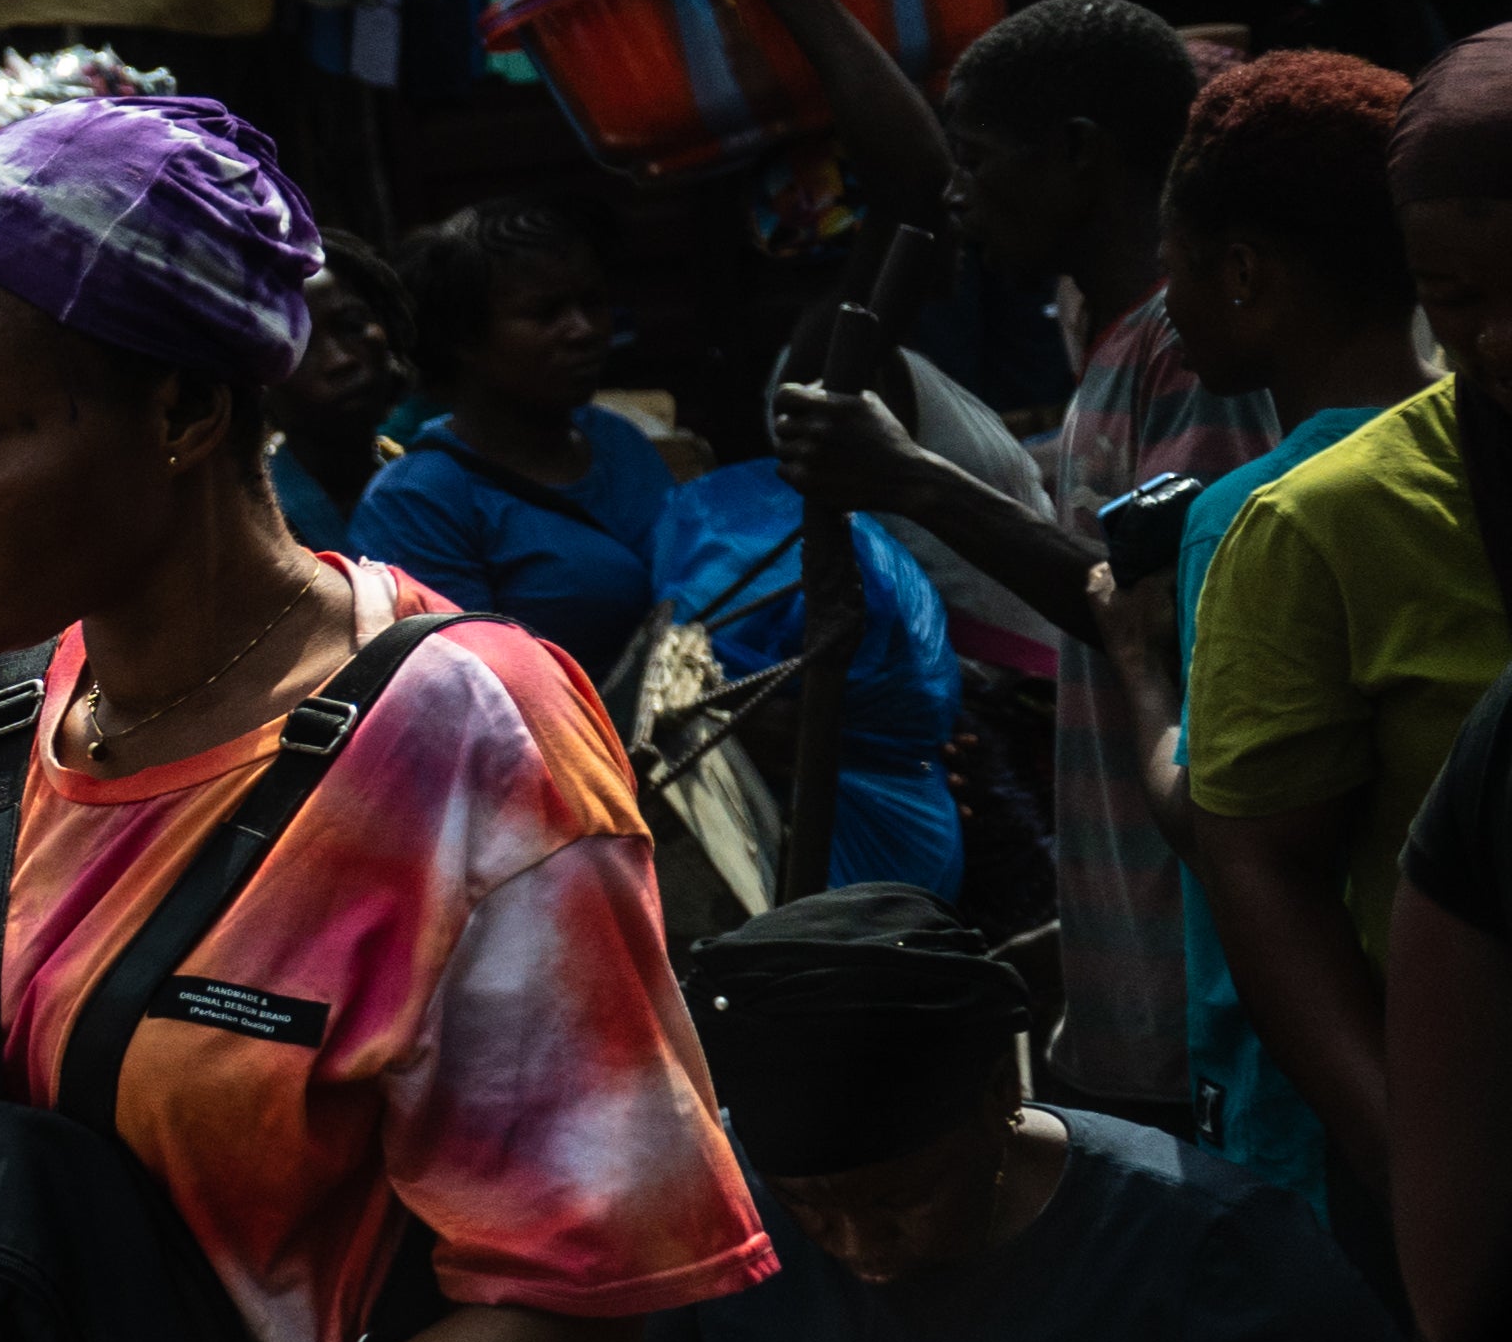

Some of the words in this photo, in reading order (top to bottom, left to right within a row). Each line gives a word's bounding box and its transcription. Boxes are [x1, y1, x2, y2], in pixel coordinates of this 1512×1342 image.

[206, 983, 260, 1004] HANDMADE
[178, 991, 222, 1009] ORIGINAL
[223, 999, 258, 1017] DESIGN
[258, 1008, 292, 1024] BRAND
